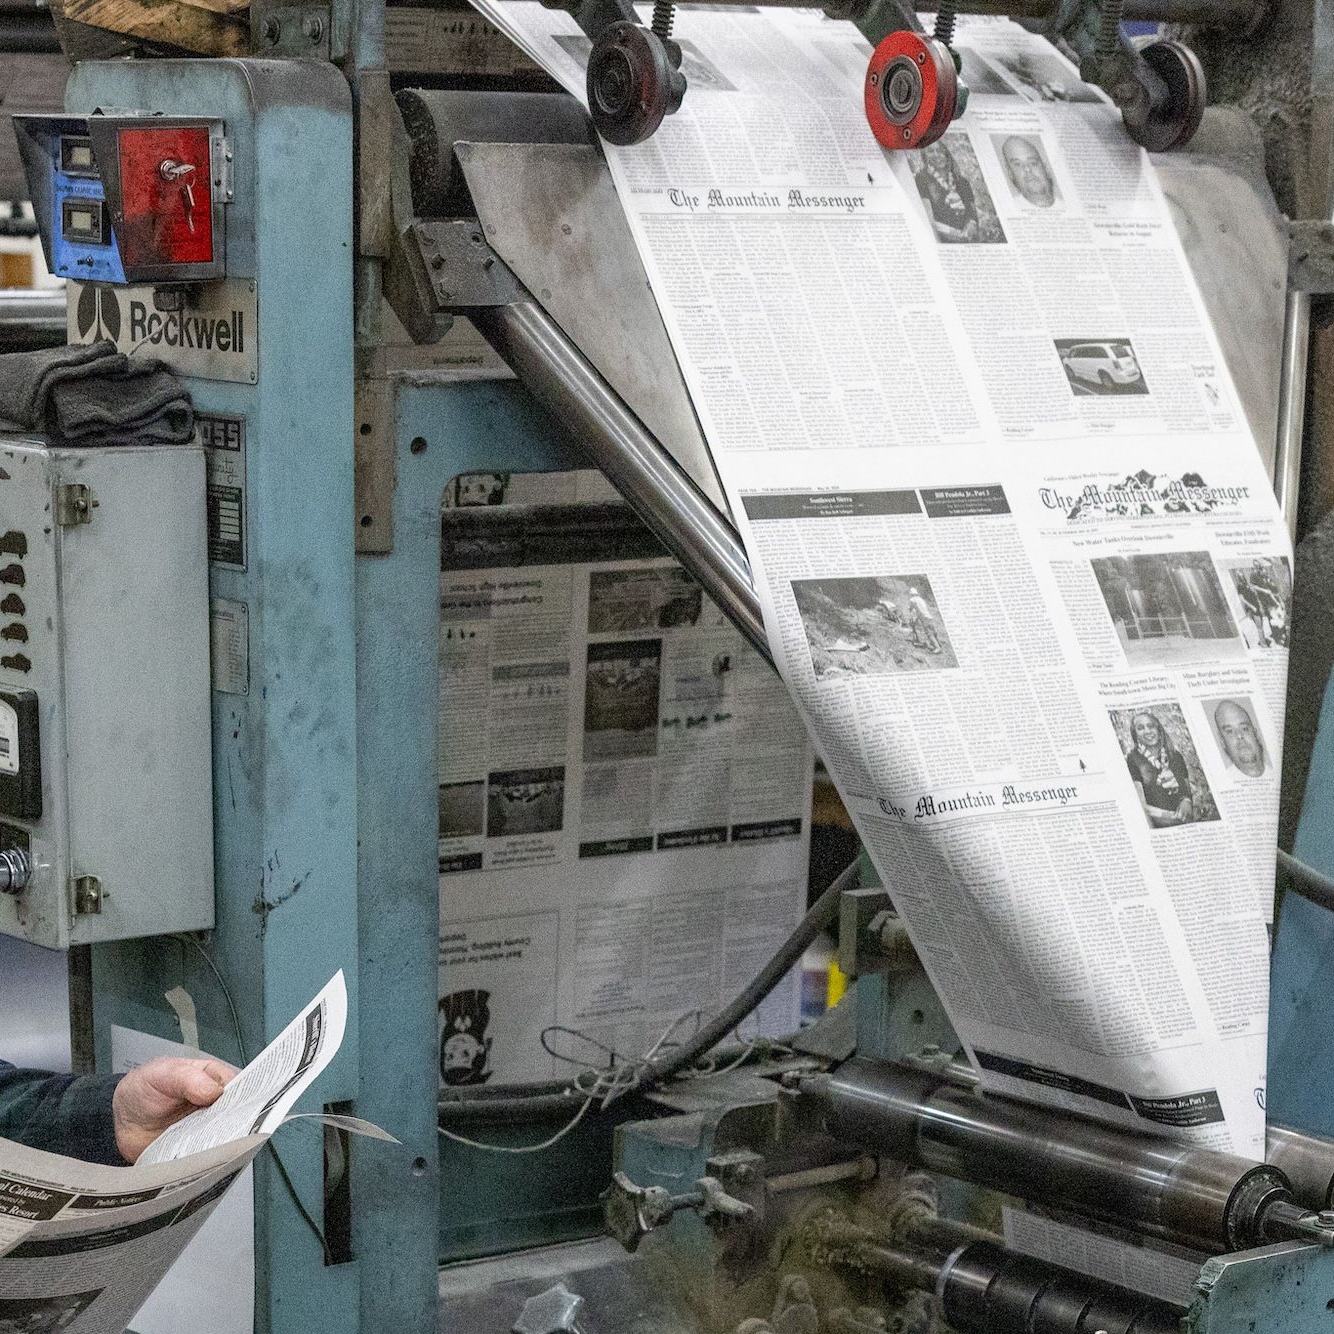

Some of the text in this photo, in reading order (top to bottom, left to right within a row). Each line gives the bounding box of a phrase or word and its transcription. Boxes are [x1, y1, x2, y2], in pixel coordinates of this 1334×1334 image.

[667, 189, 866, 212] The Mountain Messenger
[130, 301, 244, 352] Rockwell
[1039, 481, 1250, 513] The Mountain Messenger
[1109, 681, 1128, 689] Reading
[879, 785, 1078, 822] The Mountain Messenger
[9, 1183, 52, 1200] Calendar
[8, 1207, 40, 1220] Resort
